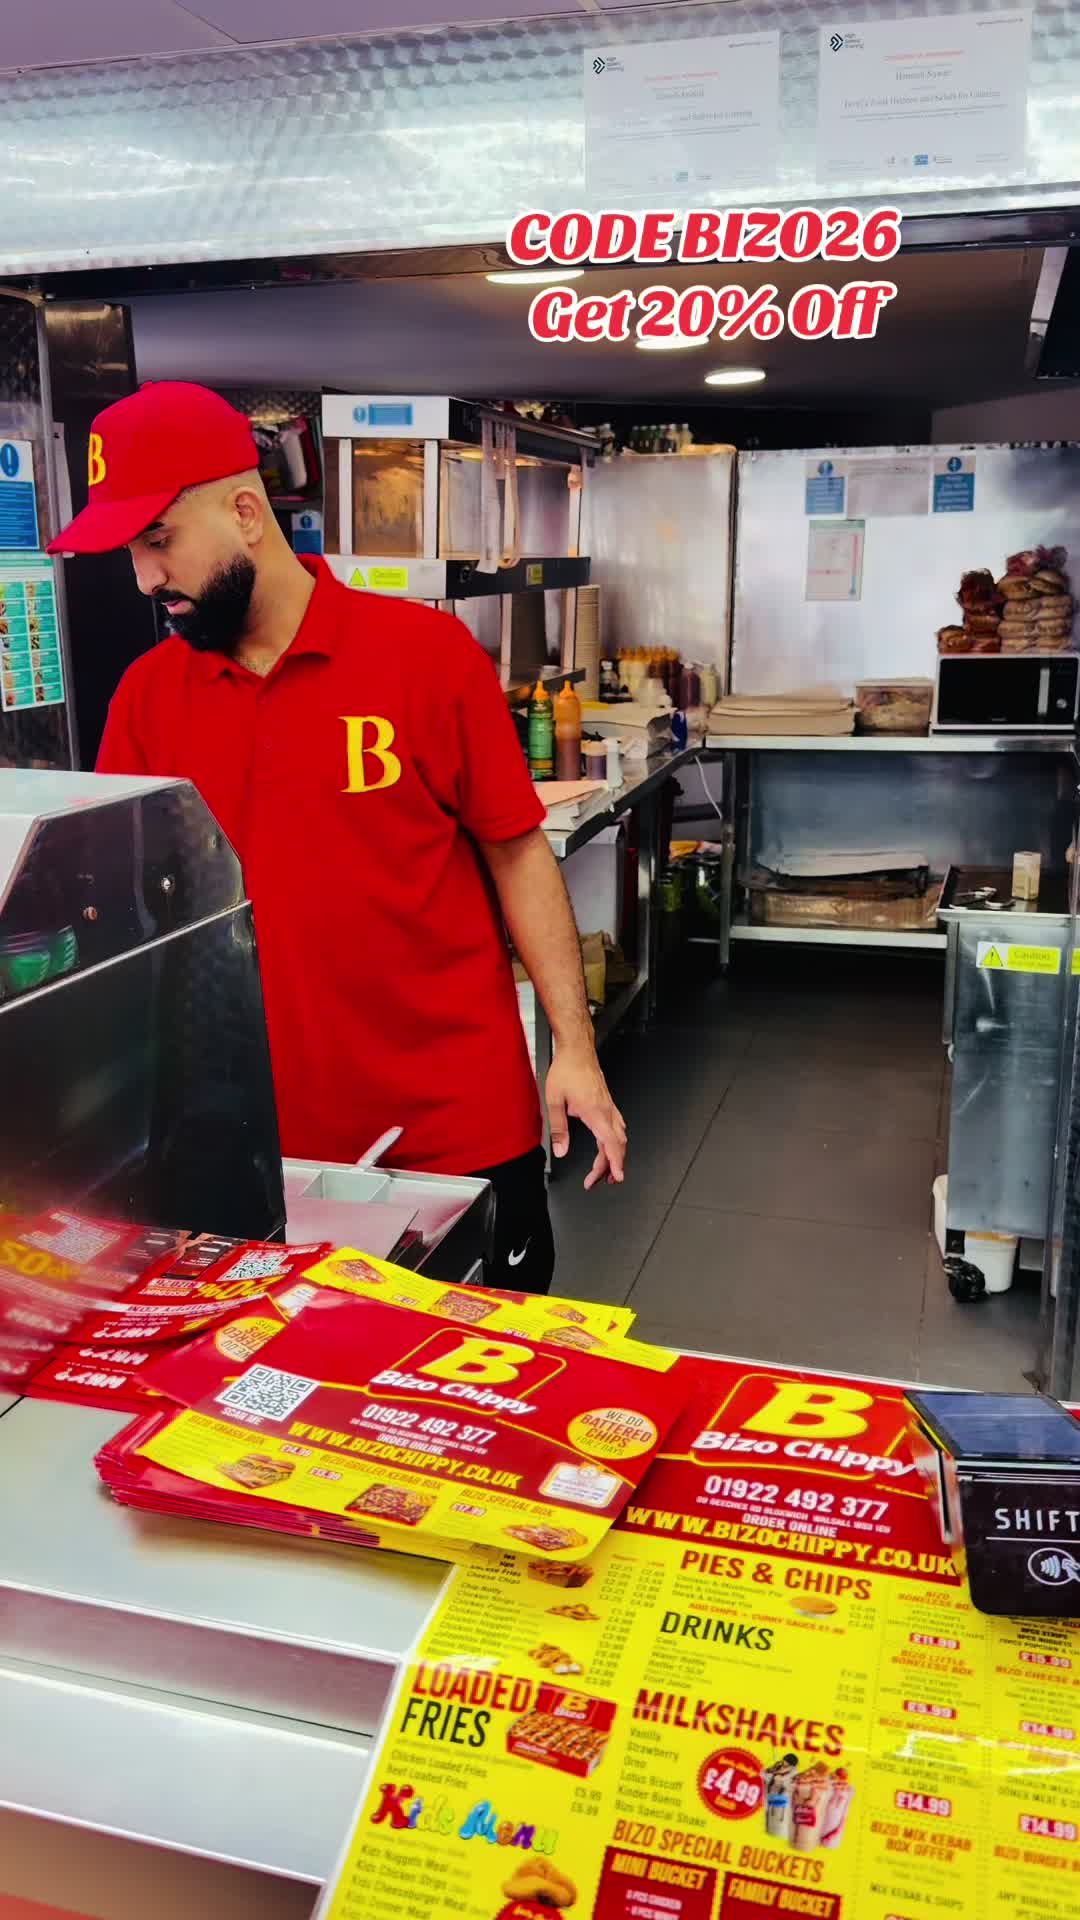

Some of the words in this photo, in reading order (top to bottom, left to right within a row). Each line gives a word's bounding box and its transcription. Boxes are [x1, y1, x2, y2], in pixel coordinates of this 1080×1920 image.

[87, 433, 107, 486] B
[337, 716, 402, 792] B
[416, 1336, 535, 1384] B
[369, 1369, 438, 1393] Bizo
[439, 1382, 537, 1415] Chippy
[740, 1382, 874, 1439] B
[361, 1404, 421, 1429] 01922
[418, 1416, 459, 1437] 492
[456, 1425, 497, 1445] 377
[579, 1414, 653, 1443] BATTERED
[585, 1428, 632, 1449] CHIPS
[606, 1410, 623, 1422] WE
[625, 1416, 644, 1427] DO
[287, 1421, 524, 1490] WWW.BIZOCHIPPY.CO.UK
[691, 1431, 779, 1454] Bizo
[783, 1440, 917, 1477] Chippy
[704, 1475, 780, 1504] 01922
[784, 1488, 836, 1513] 492
[841, 1497, 889, 1521] 377
[626, 1506, 960, 1577] WWW.BIZOCHIPPY.CO.UK
[741, 1513, 787, 1531] ORDER
[788, 1519, 838, 1538] ONLINE
[680, 1550, 745, 1579] PIES
[751, 1562, 775, 1585] &
[784, 1567, 874, 1601] CHIPS
[659, 1610, 776, 1652] DRINKS
[411, 1661, 534, 1714] LOADED
[400, 1697, 491, 1748] FRIES
[632, 1688, 846, 1757] MILKSHAKES
[703, 1767, 762, 1807] £4.99
[458, 1800, 560, 1856] Menu
[612, 1820, 658, 1847] BIZO
[658, 1829, 733, 1865] SPECIAL
[738, 1845, 826, 1884] BUCKETS
[648, 1860, 708, 1890] BUCKET
